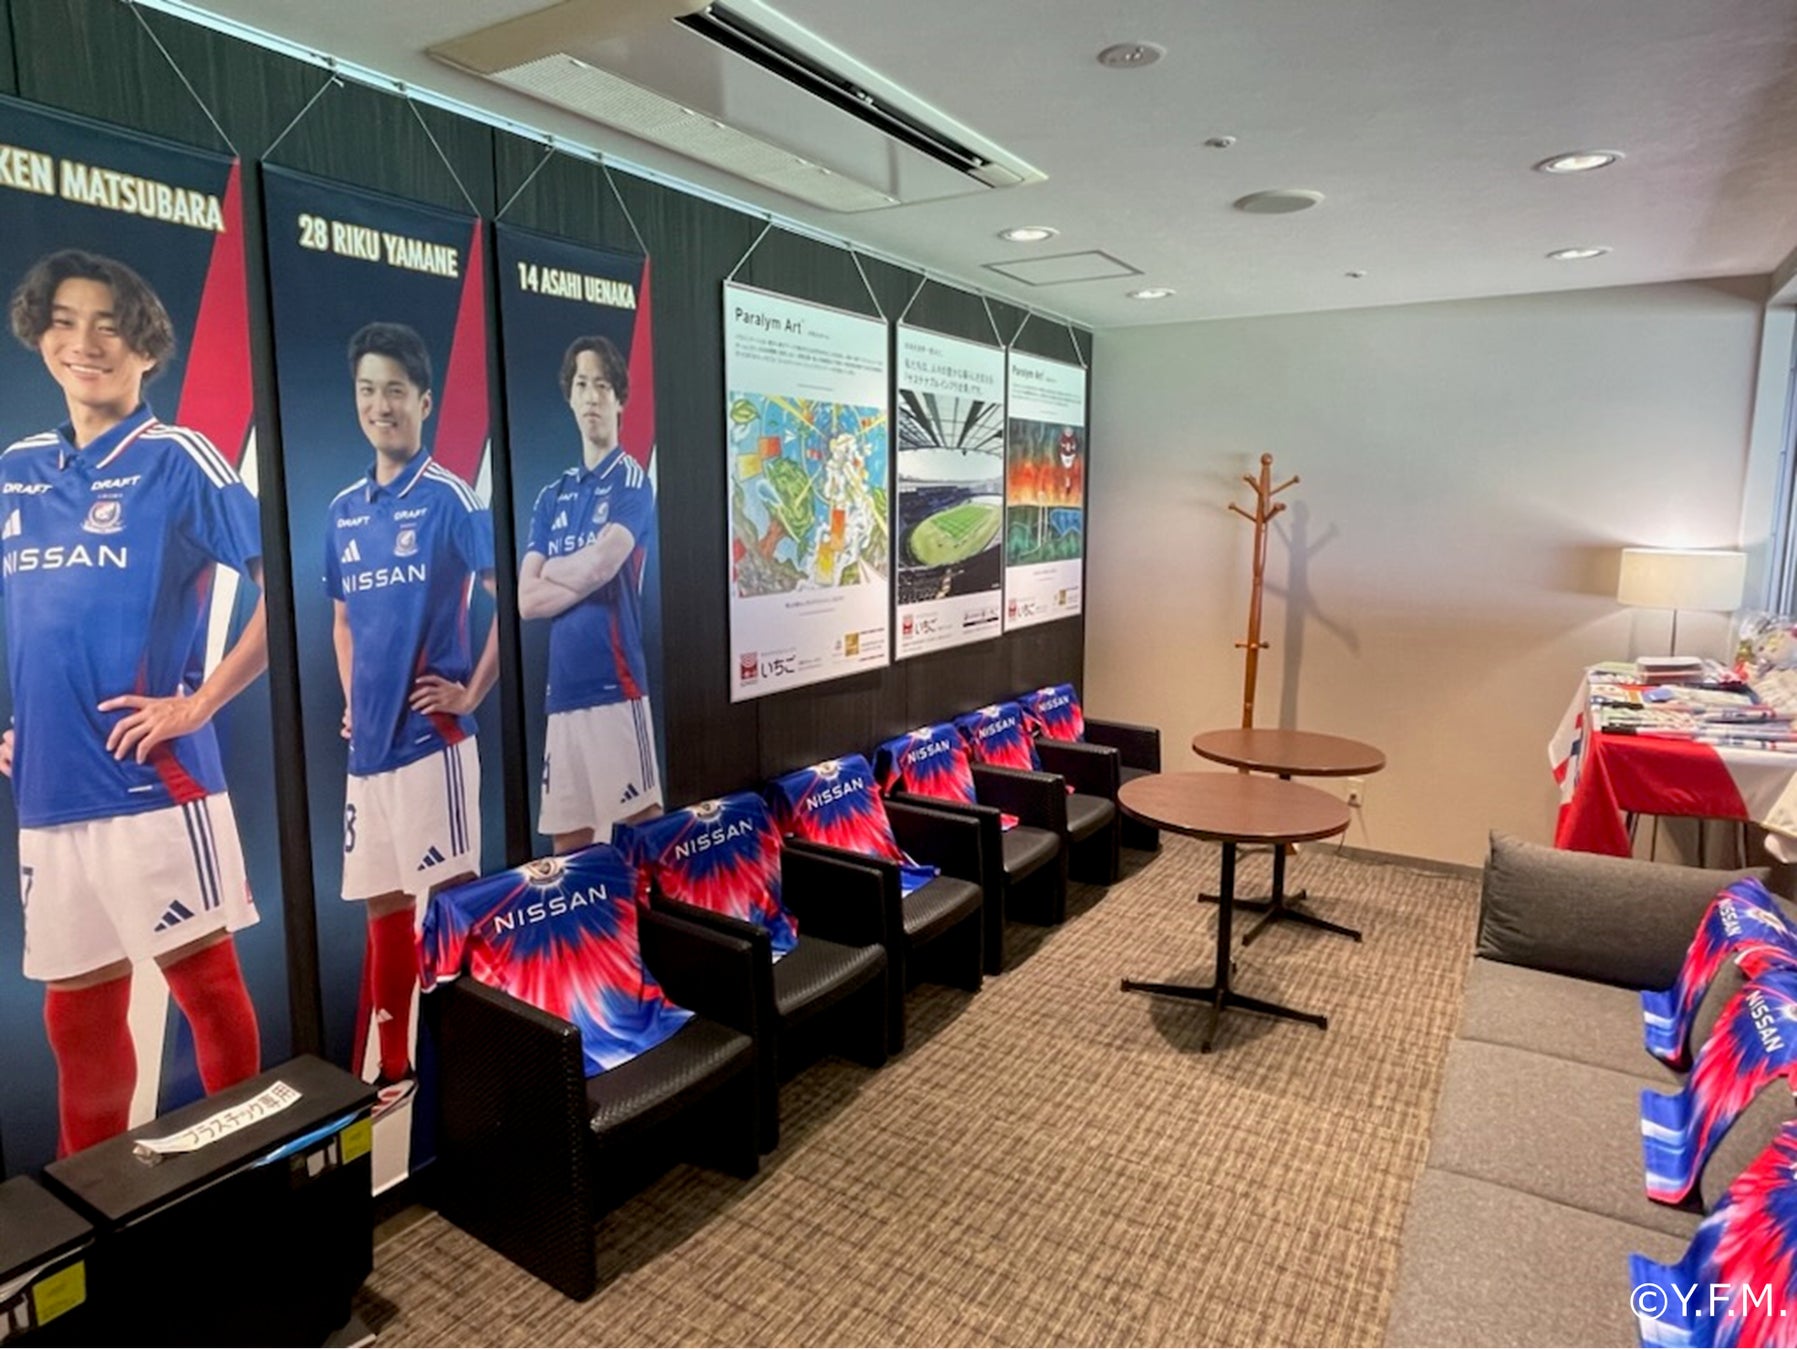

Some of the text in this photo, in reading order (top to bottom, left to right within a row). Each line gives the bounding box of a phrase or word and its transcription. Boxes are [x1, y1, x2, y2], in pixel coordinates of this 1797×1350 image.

[60, 160, 225, 232] MATSUBARA
[298, 213, 459, 278] 28 RIKU YAMANE
[518, 261, 636, 310] 14 ASAHI UENAKA
[735, 307, 803, 334] Paralym Art
[3, 482, 53, 494] DRAFT
[91, 475, 141, 491] DRAFT
[3, 544, 127, 580] NISSAN
[342, 564, 426, 594] NISSAN
[761, 654, 796, 678] いちご
[1038, 695, 1070, 713] NISSAN
[978, 716, 1016, 739] NISSAN
[907, 739, 951, 765] NISSAN
[806, 777, 864, 812] NISSAN
[674, 818, 753, 860] NISSAN
[494, 884, 607, 934] NISSAN
[1746, 989, 1785, 1053] NISSAN
